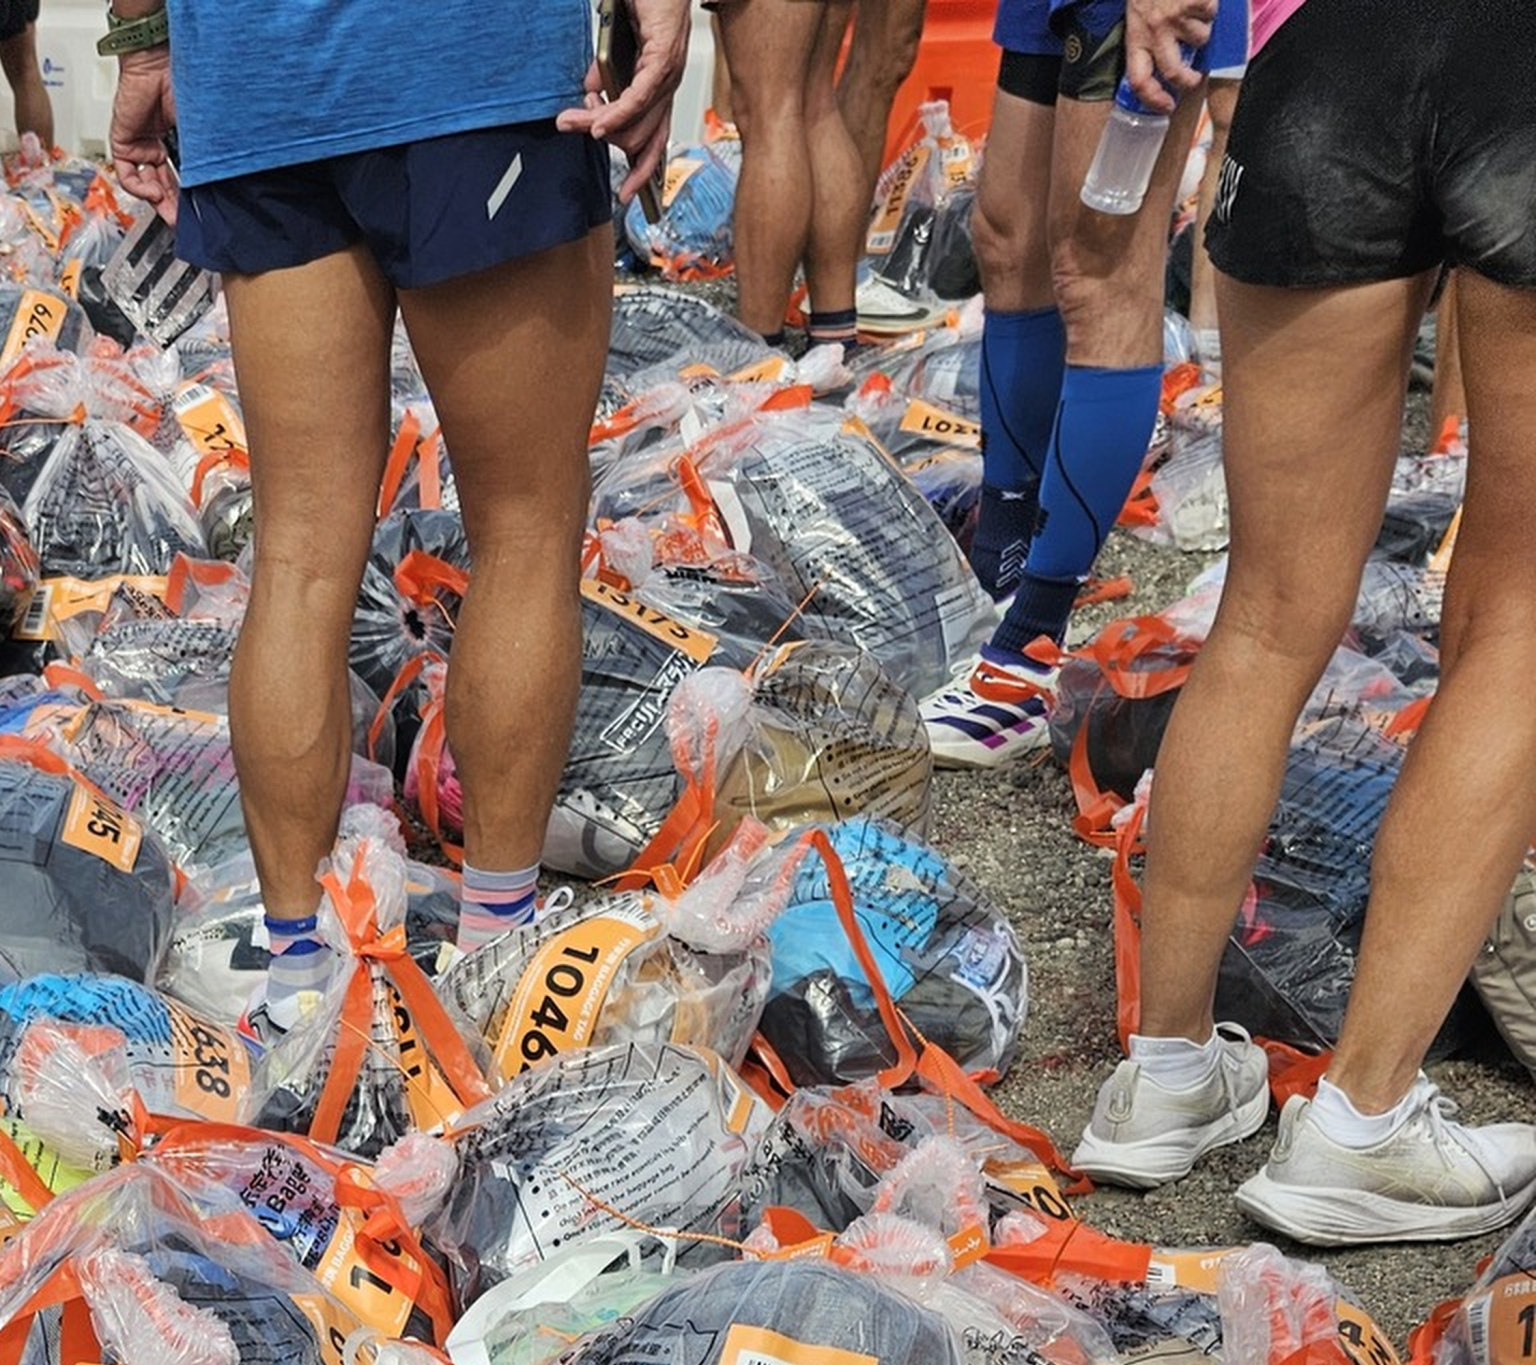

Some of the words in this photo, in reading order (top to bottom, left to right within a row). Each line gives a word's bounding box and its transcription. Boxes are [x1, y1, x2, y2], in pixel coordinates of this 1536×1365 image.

[505, 944, 598, 1085] 1046
[585, 958, 612, 1017] BAGGAGE
[573, 1017, 591, 1042] TAG
